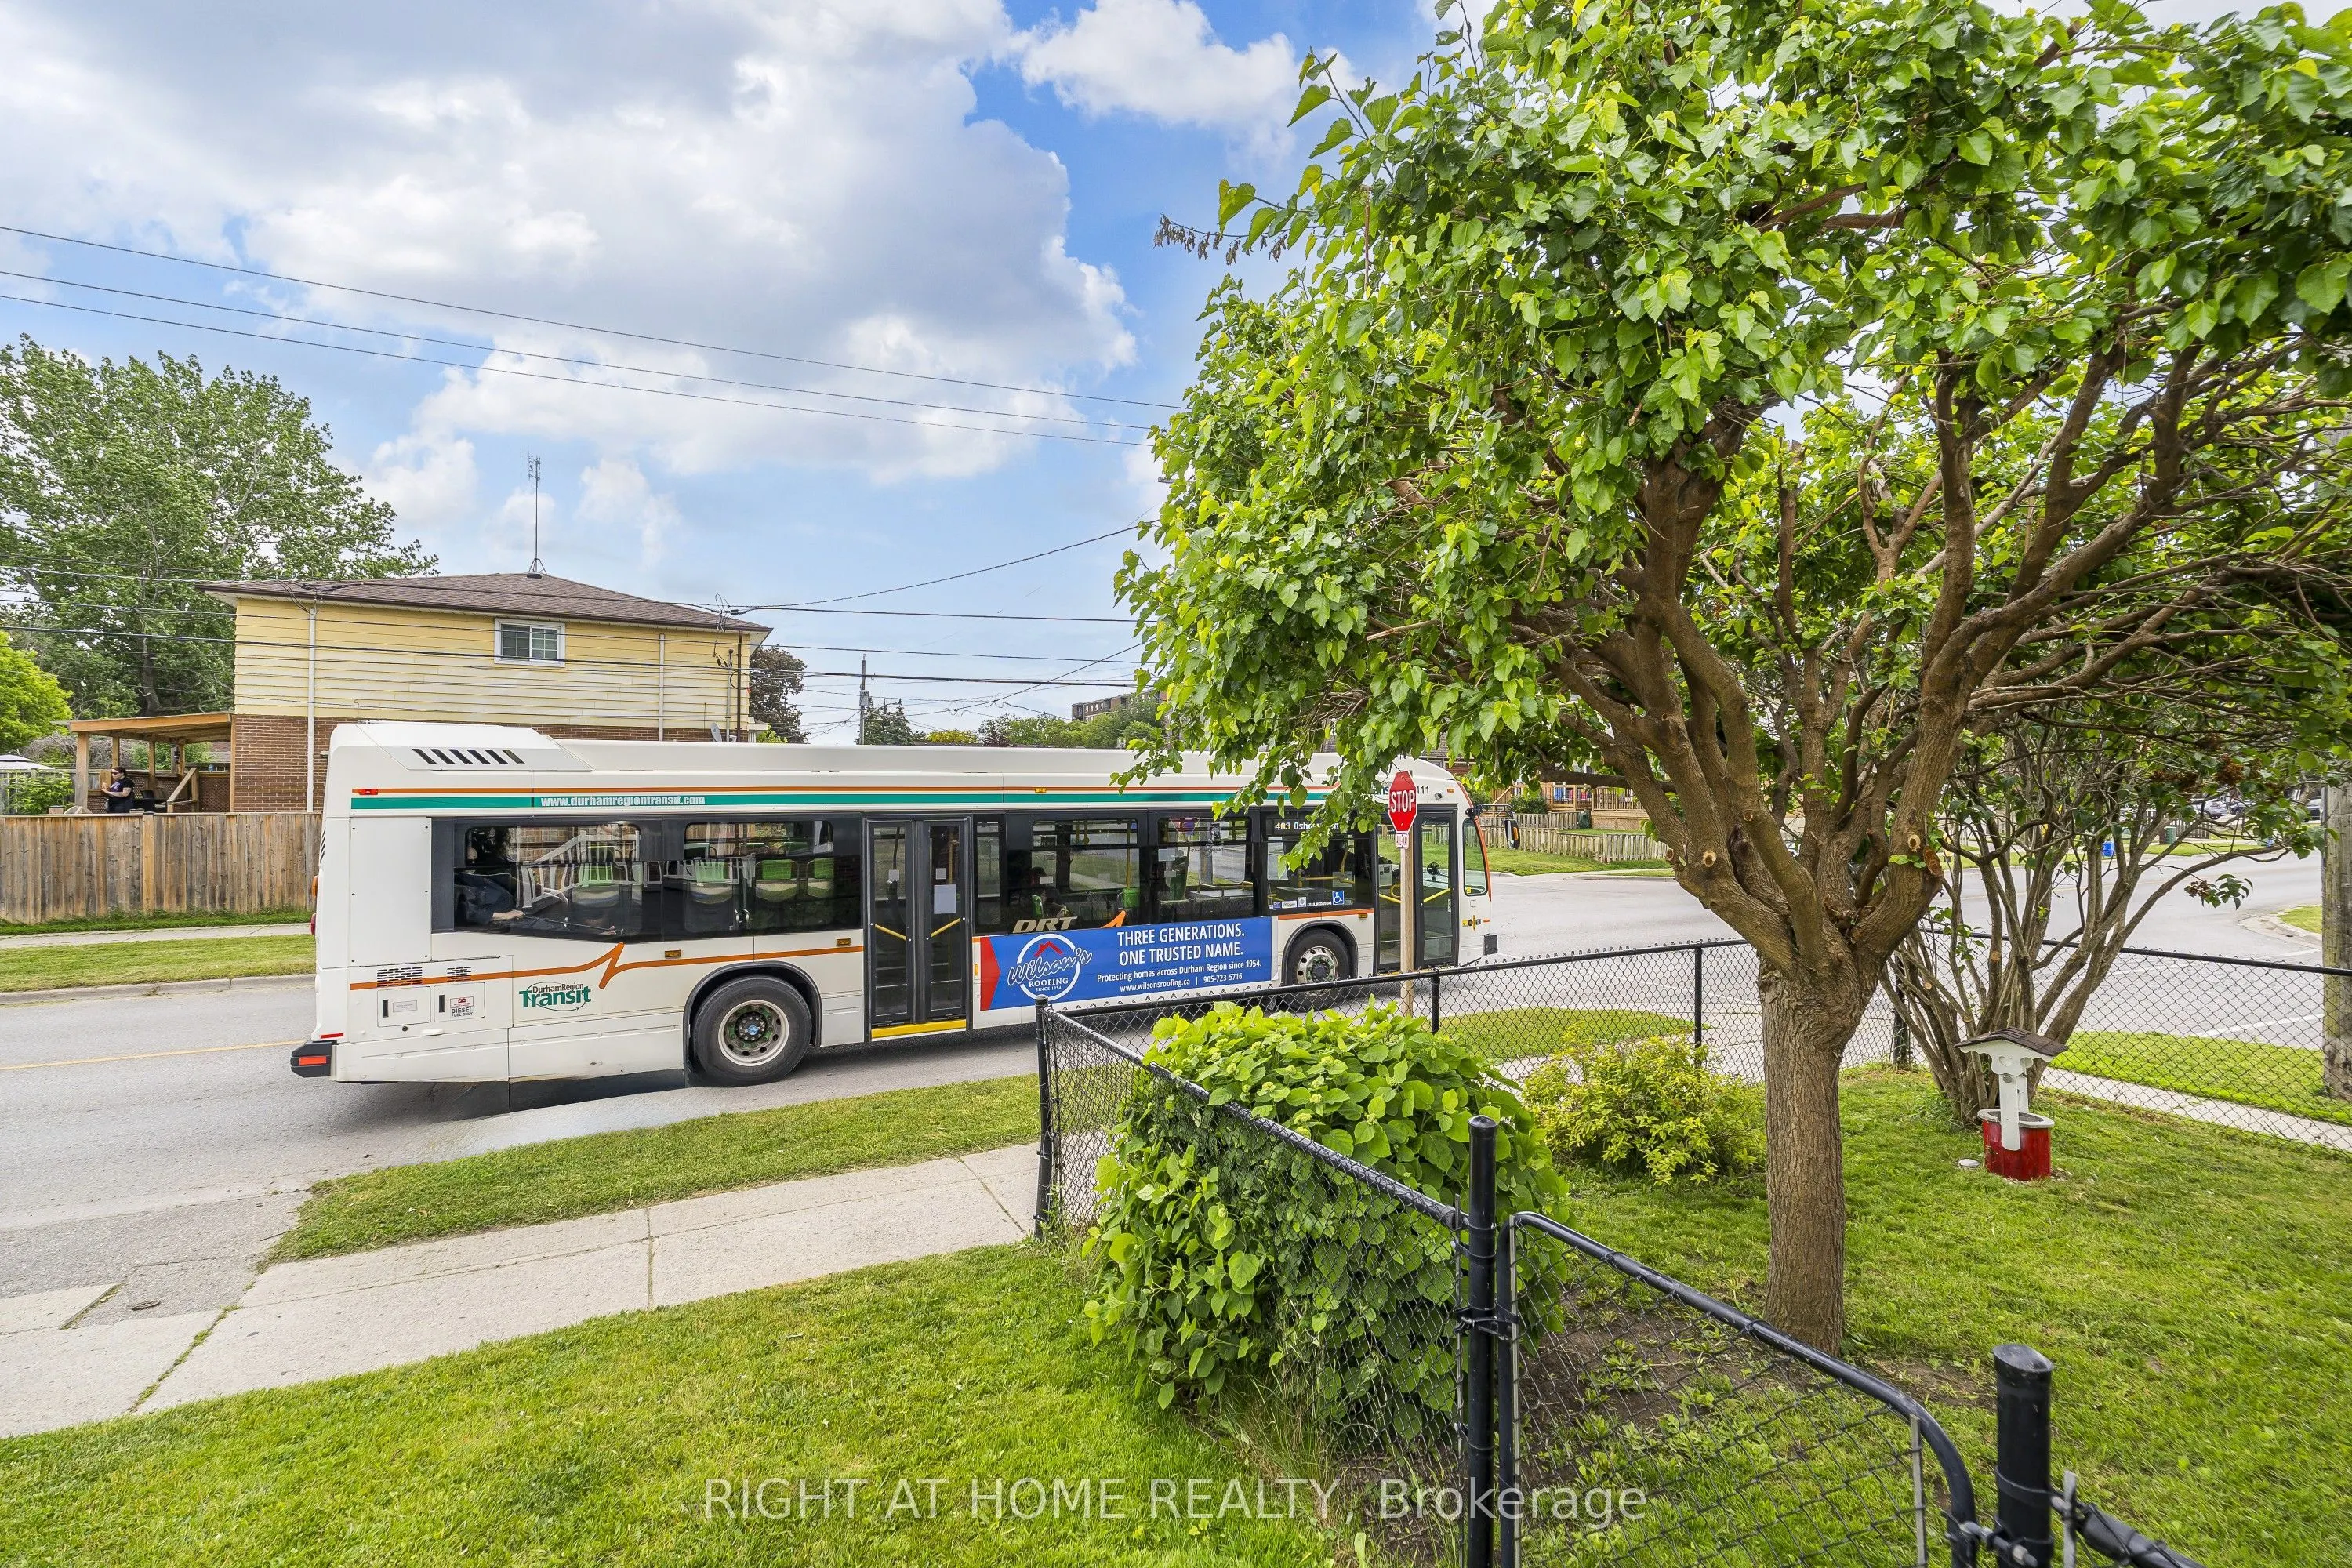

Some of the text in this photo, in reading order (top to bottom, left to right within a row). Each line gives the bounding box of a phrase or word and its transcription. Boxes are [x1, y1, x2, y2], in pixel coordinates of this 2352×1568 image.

[541, 796, 705, 806] www.durhamregiontransit.com
[1391, 789, 1415, 813] STOP
[1275, 822, 1291, 830] 403
[1012, 916, 1078, 933] DRT
[1117, 923, 1245, 946] THREE GENERATIONS.
[1120, 942, 1243, 966] ONE TRUSTED NAME.
[1007, 947, 1093, 986] Wilson's
[1097, 971, 1133, 982] Protecting
[1134, 971, 1156, 979] homes
[1179, 965, 1204, 975] Durham
[1206, 963, 1227, 973] Region
[1246, 959, 1262, 967] 1954.
[533, 982, 584, 993] DurhamRegion
[1029, 977, 1069, 987] ROOFING
[1120, 973, 1243, 993] www.wilsonsroofing.ca 905-723-5716
[518, 985, 592, 1008] Transit
